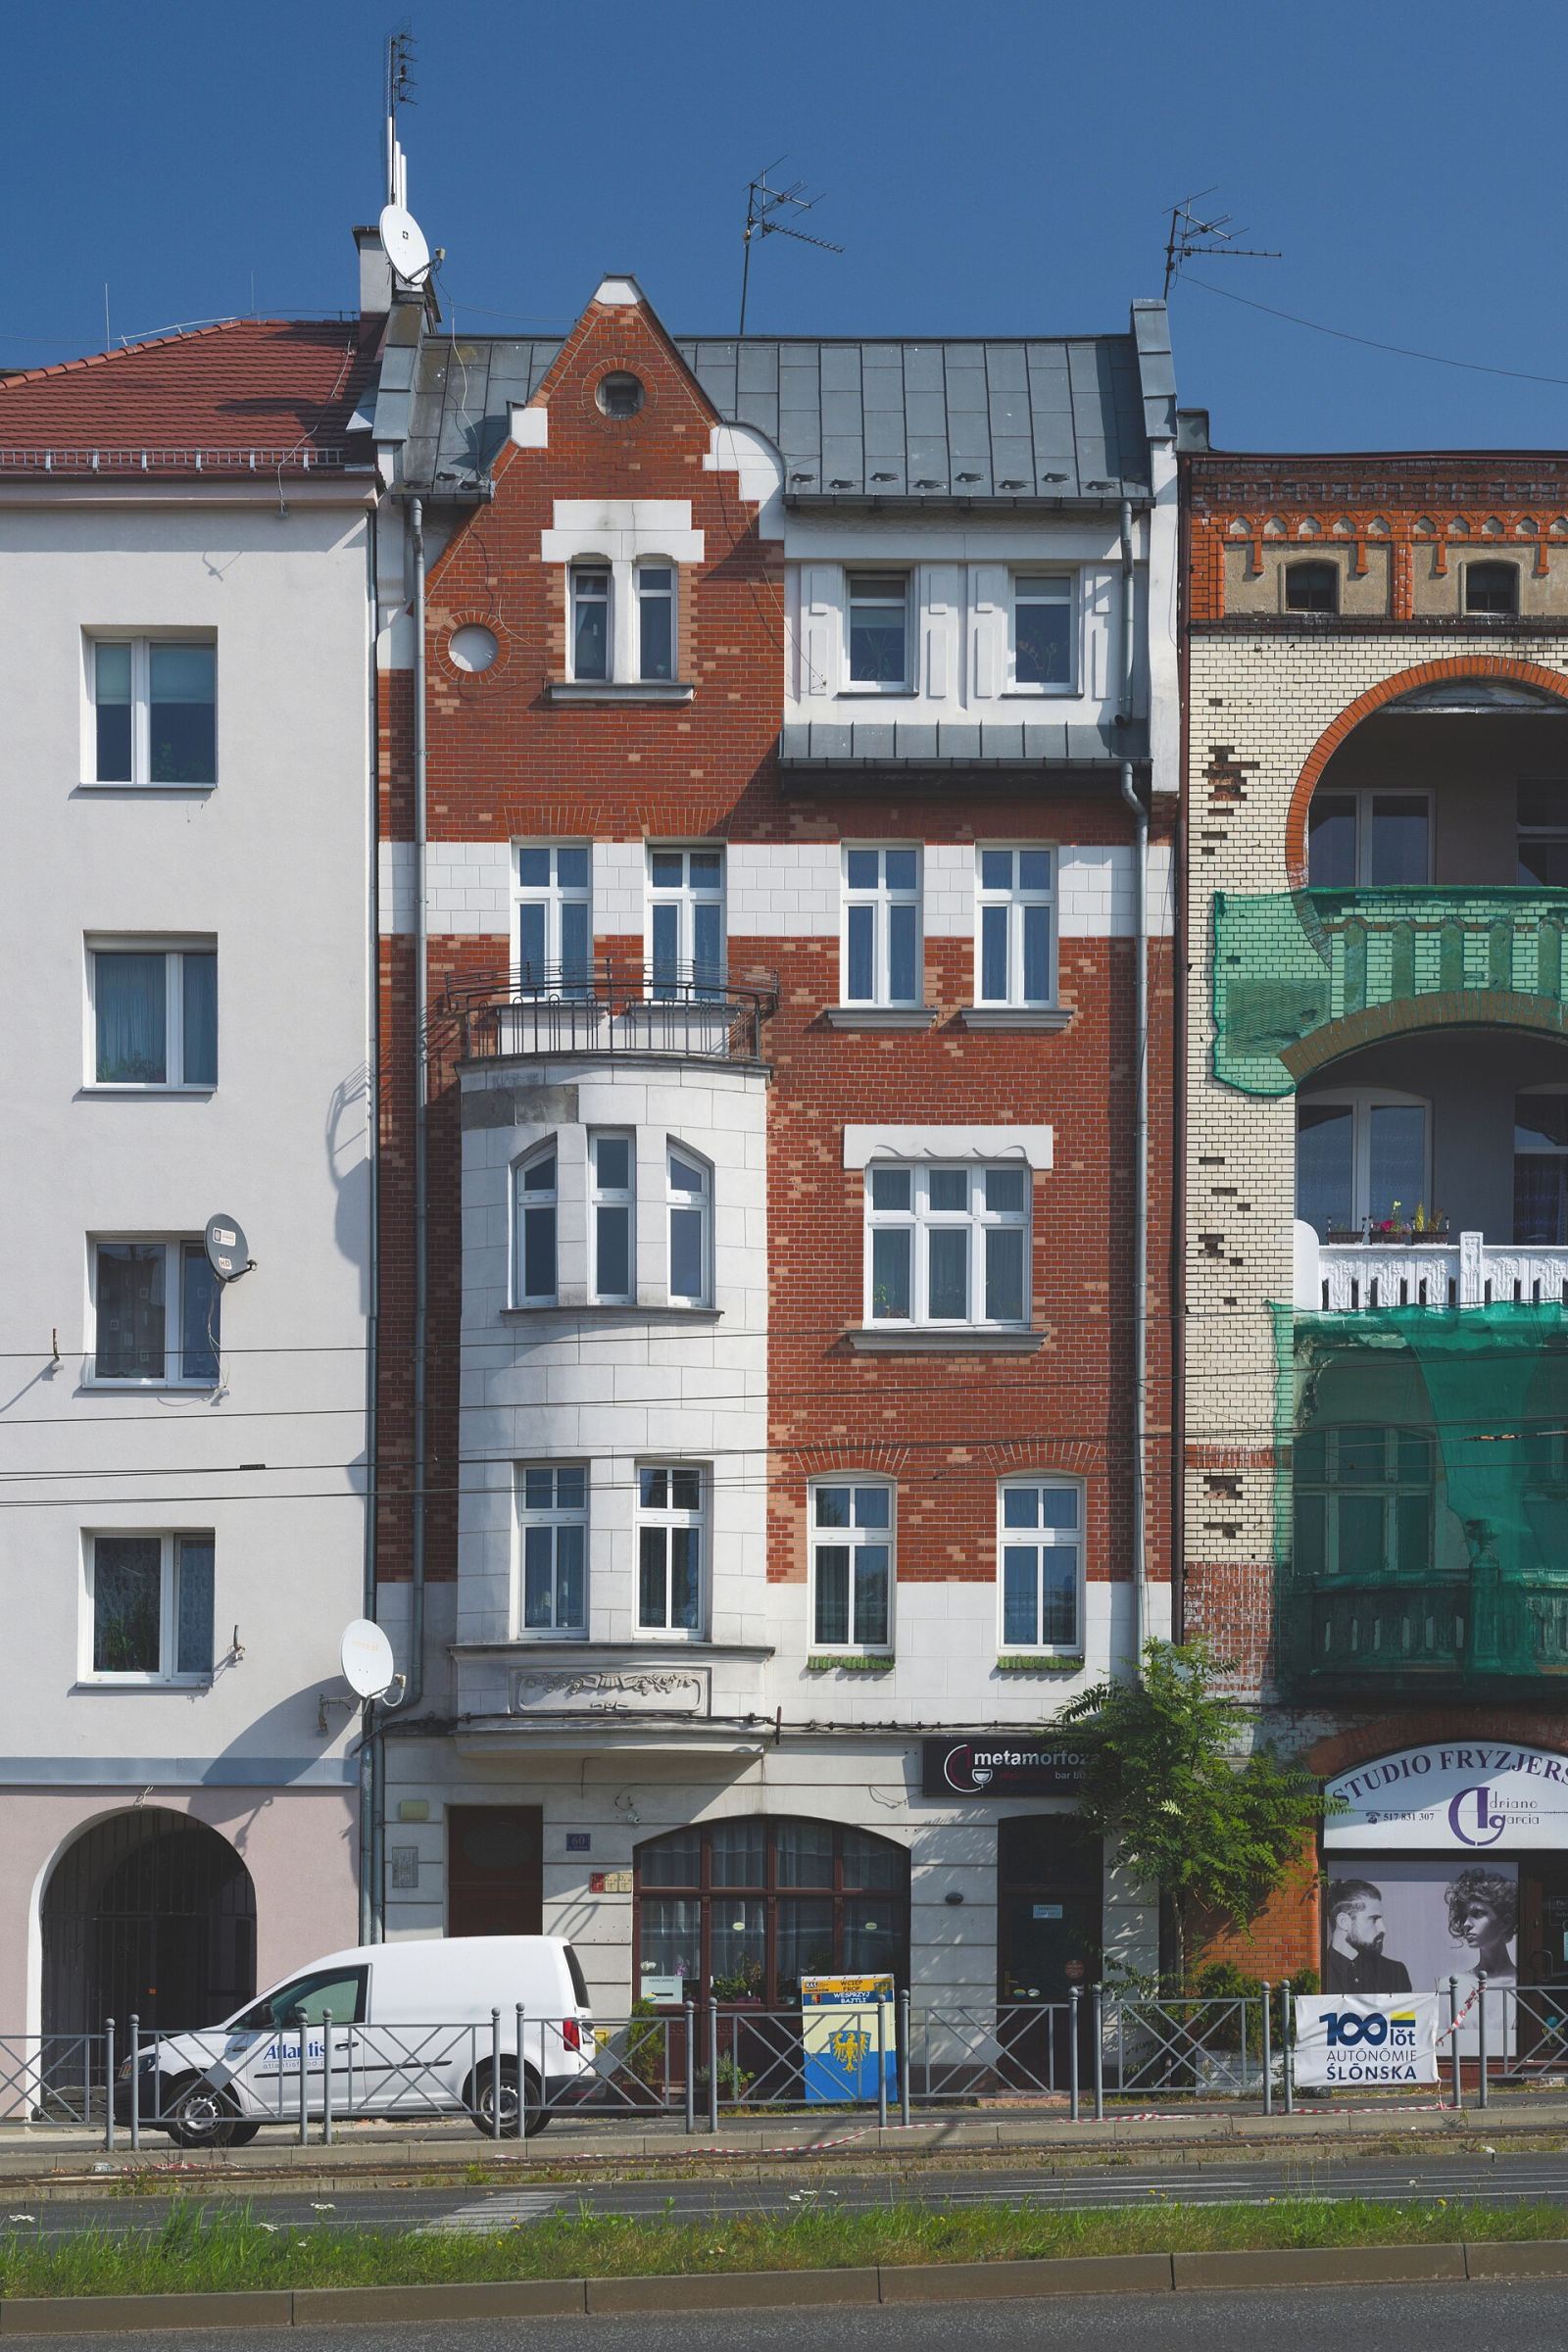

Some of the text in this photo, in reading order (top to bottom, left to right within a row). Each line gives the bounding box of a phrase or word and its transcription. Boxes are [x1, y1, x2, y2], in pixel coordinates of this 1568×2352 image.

[974, 1749, 1100, 1765] metamorfoza
[1332, 1754, 1433, 1807] STUDIO
[1319, 2012, 1388, 2046] 100
